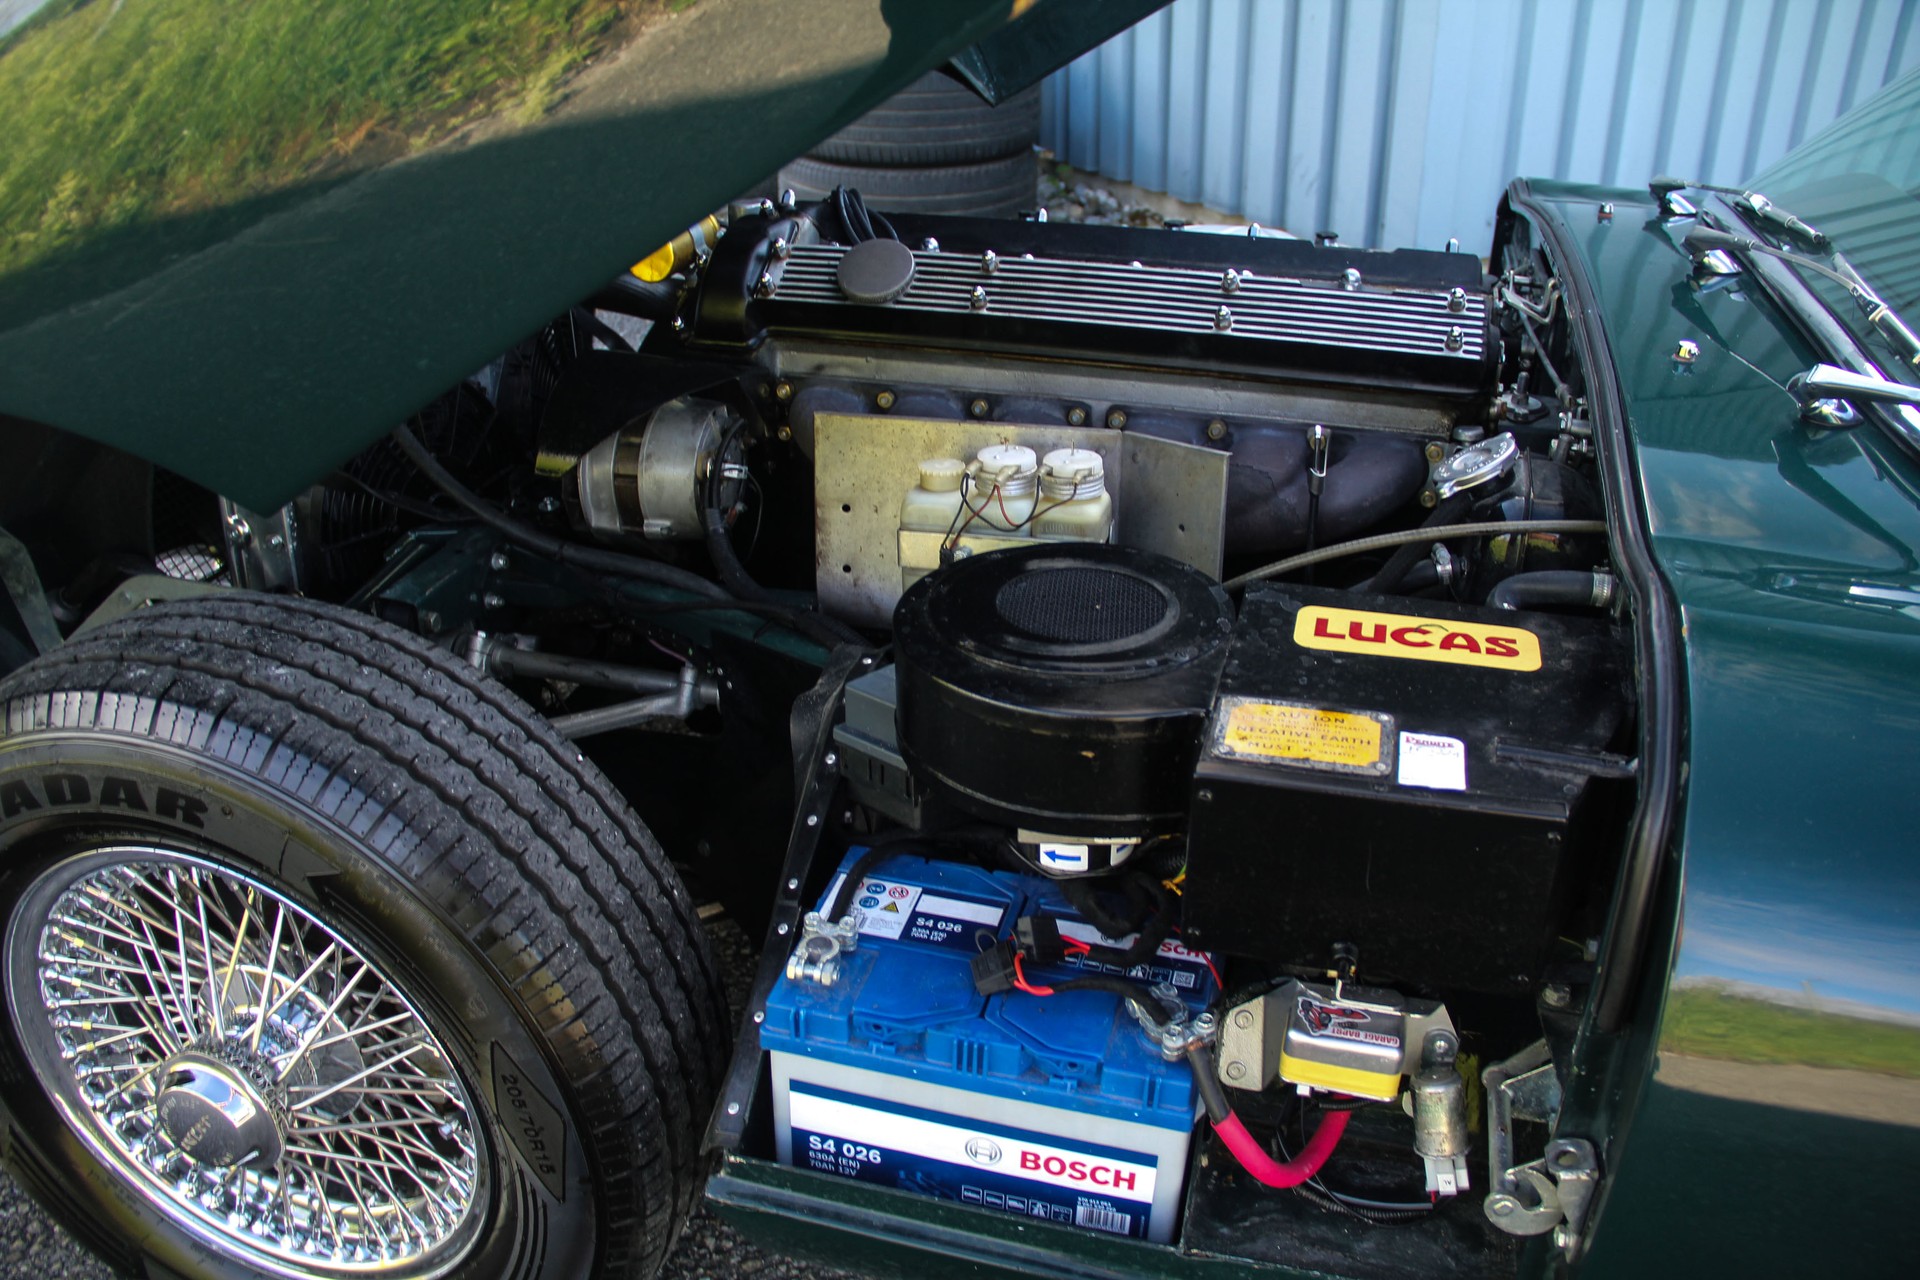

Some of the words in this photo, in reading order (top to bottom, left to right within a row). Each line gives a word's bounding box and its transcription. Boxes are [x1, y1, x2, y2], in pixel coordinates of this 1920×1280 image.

[1313, 617, 1520, 658] LUCAS
[1265, 710, 1345, 724] CAUTION
[1321, 734, 1371, 746] EARTH
[0, 774, 209, 830] ADAR
[915, 917, 934, 928] S4
[937, 920, 962, 933] 026
[809, 1134, 836, 1154] S4
[842, 1142, 882, 1164] 026
[809, 1150, 835, 1163] 630A
[838, 1156, 860, 1170] (EN)
[1019, 1150, 1136, 1191] BOSCH
